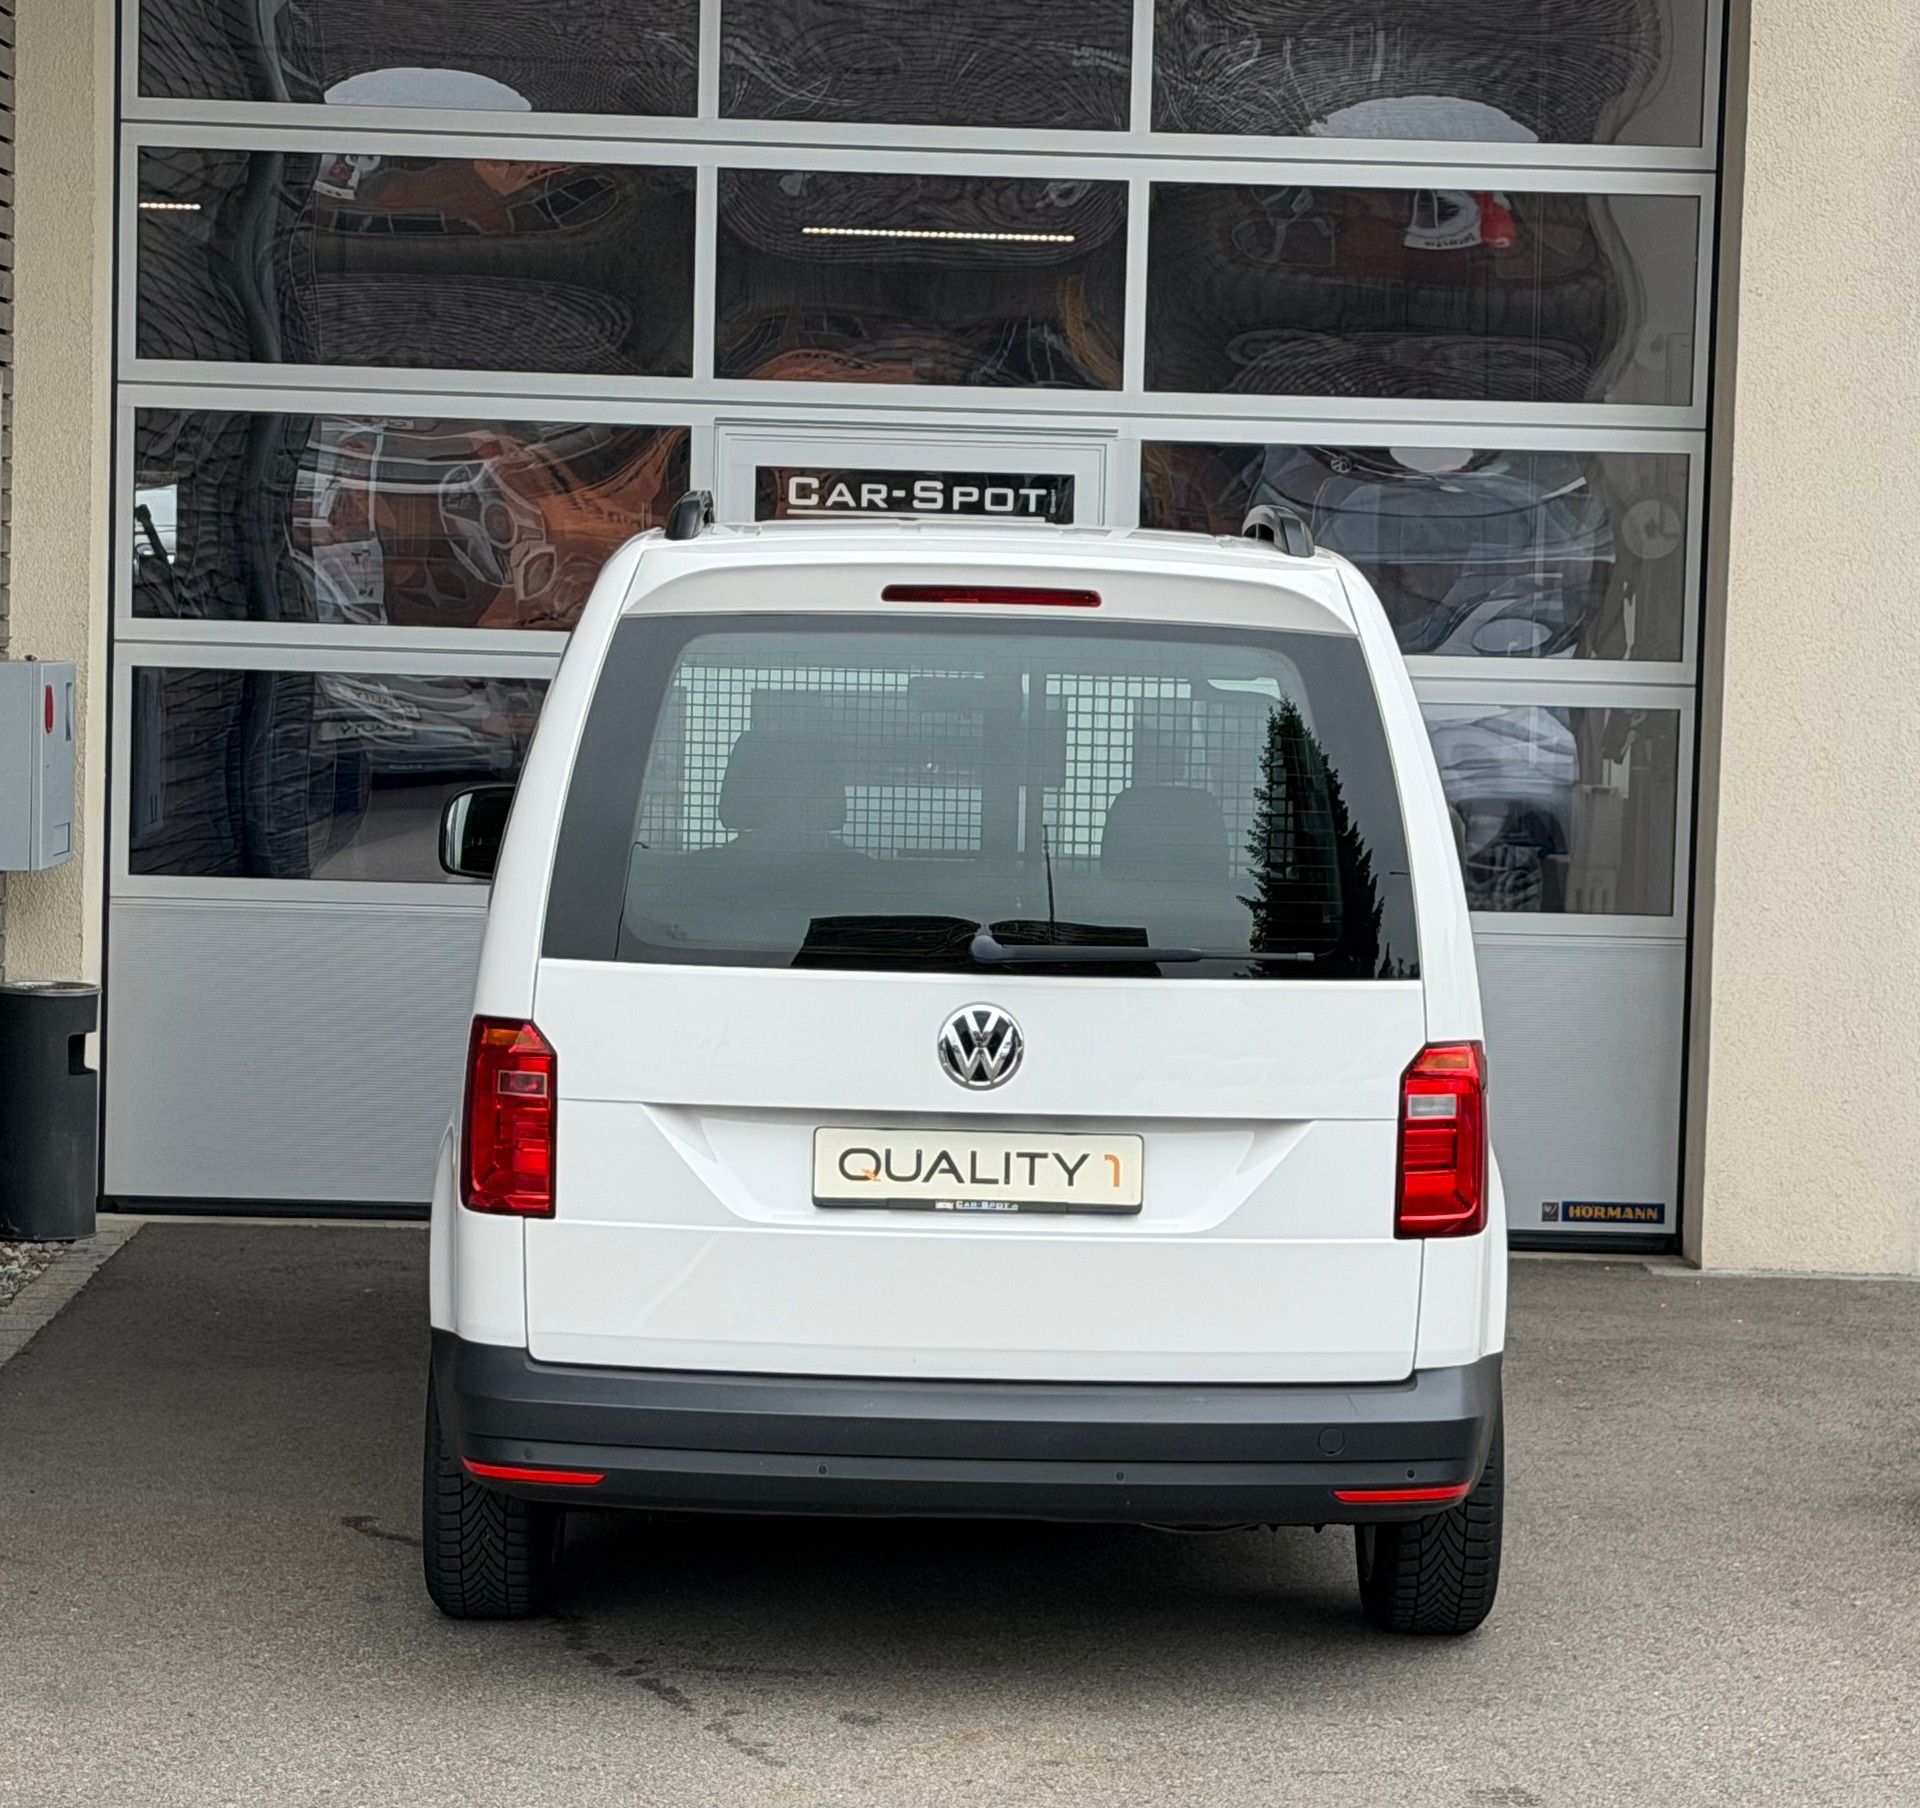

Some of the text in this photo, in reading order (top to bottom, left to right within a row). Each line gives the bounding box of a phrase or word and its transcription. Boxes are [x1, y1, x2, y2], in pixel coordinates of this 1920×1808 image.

[788, 477, 1047, 512] CAR-SPOT
[838, 1147, 1121, 1188] QUALITY 1
